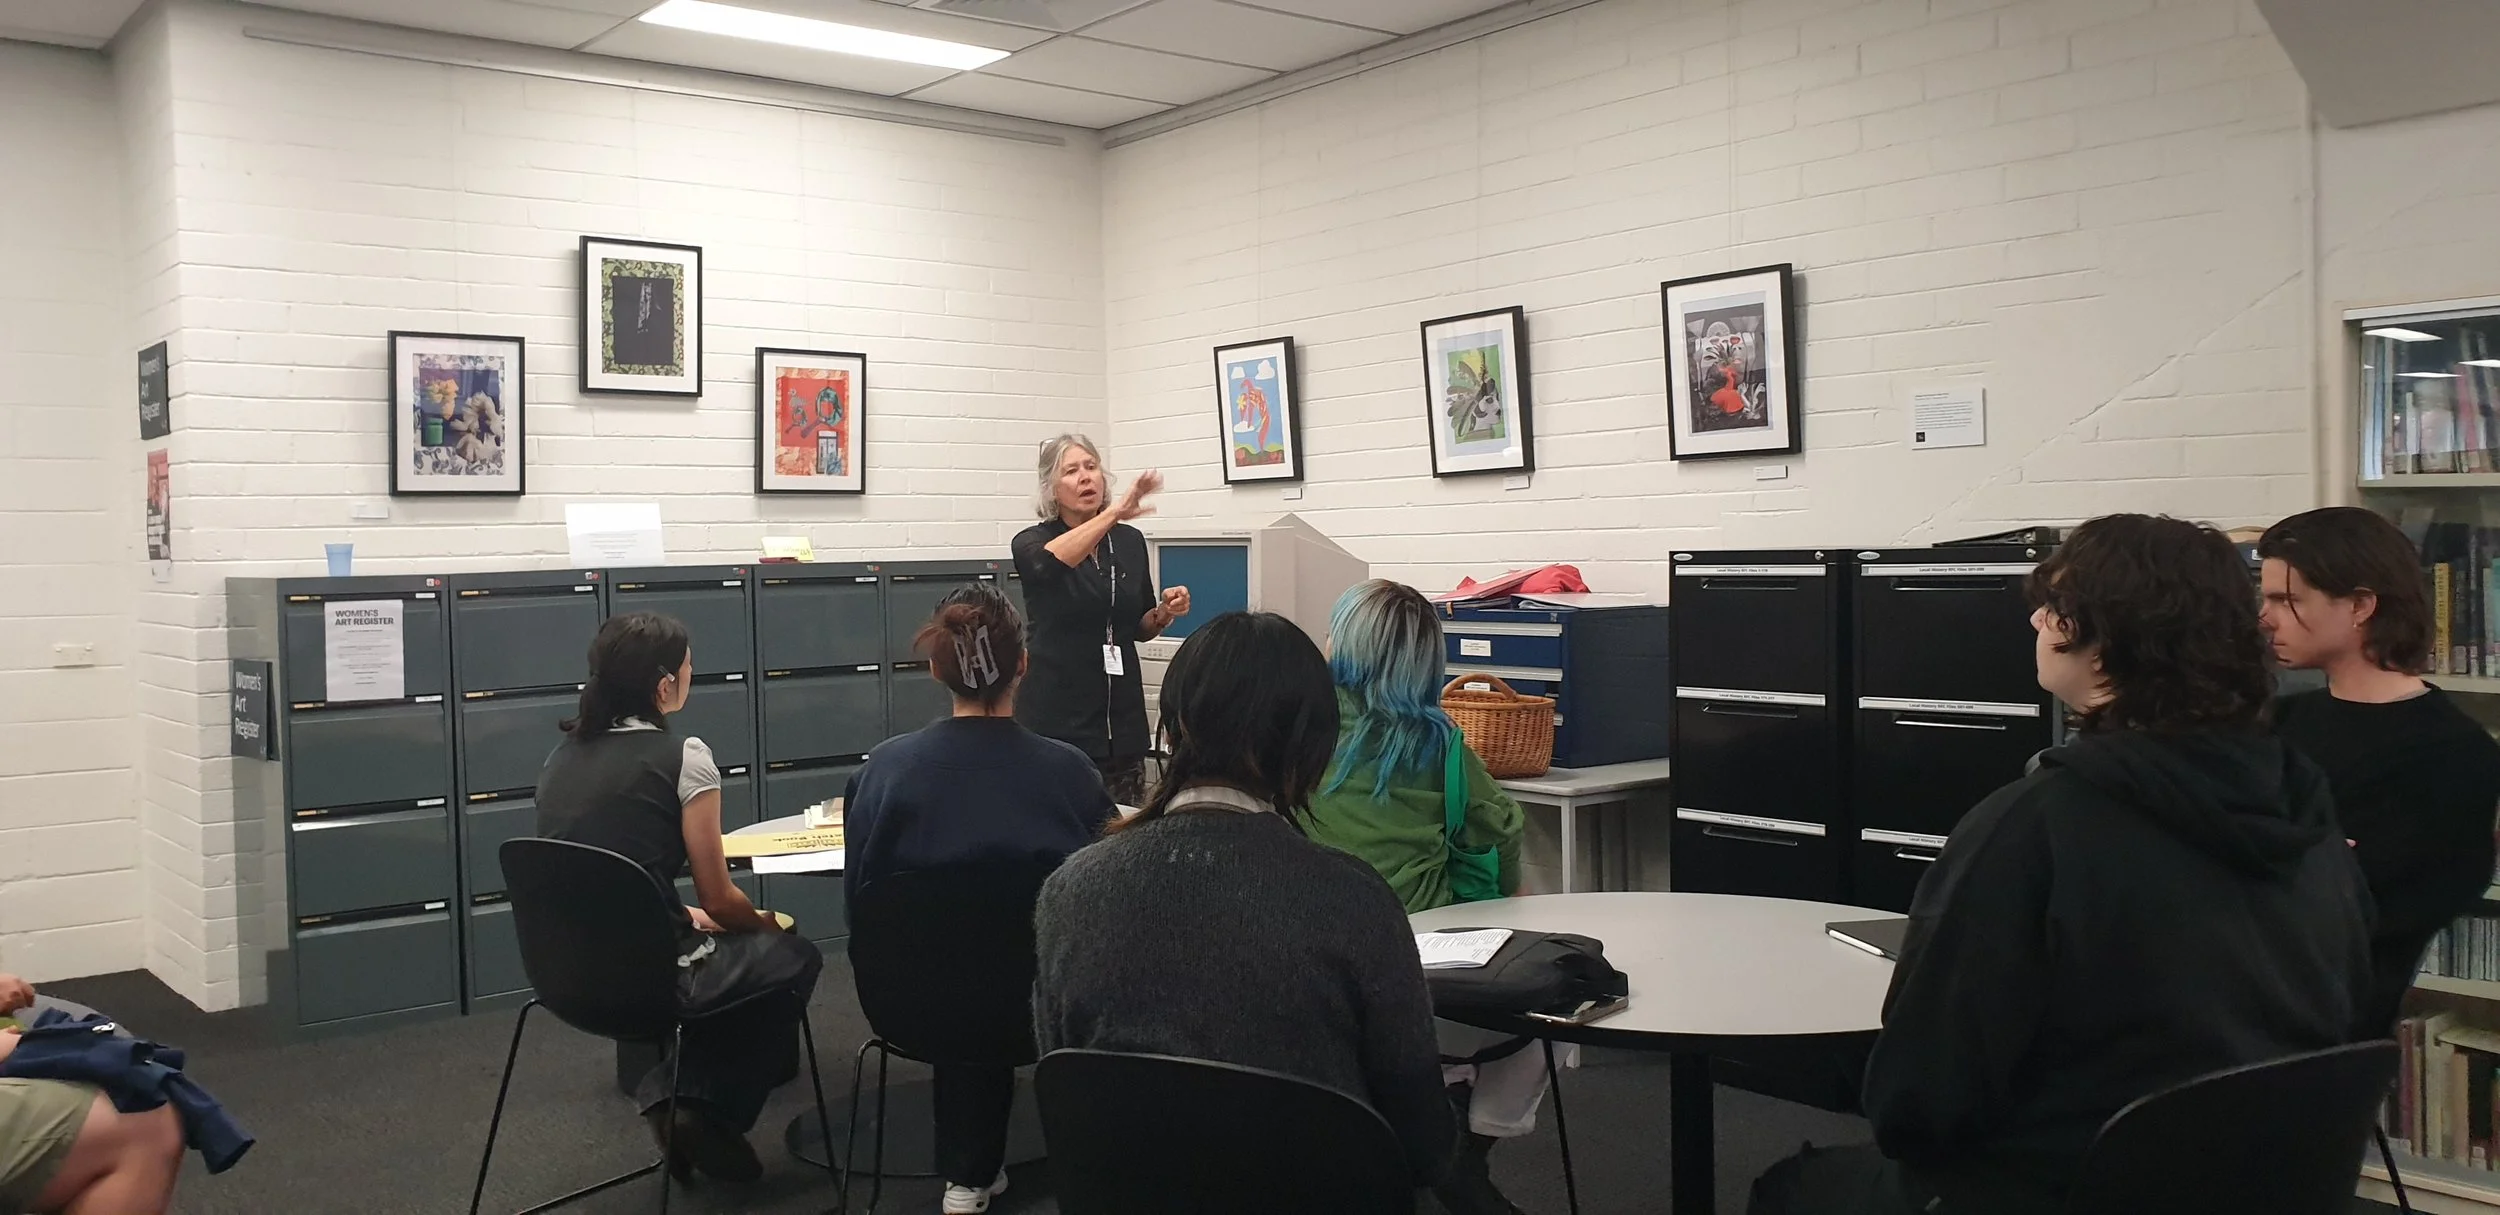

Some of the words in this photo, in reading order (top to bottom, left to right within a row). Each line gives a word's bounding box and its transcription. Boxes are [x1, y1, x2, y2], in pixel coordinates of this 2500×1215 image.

[335, 618, 352, 626] ART
[353, 617, 394, 626] REGISTER
[235, 671, 262, 692] Women's
[235, 694, 247, 713] Art
[235, 717, 260, 740] Register
